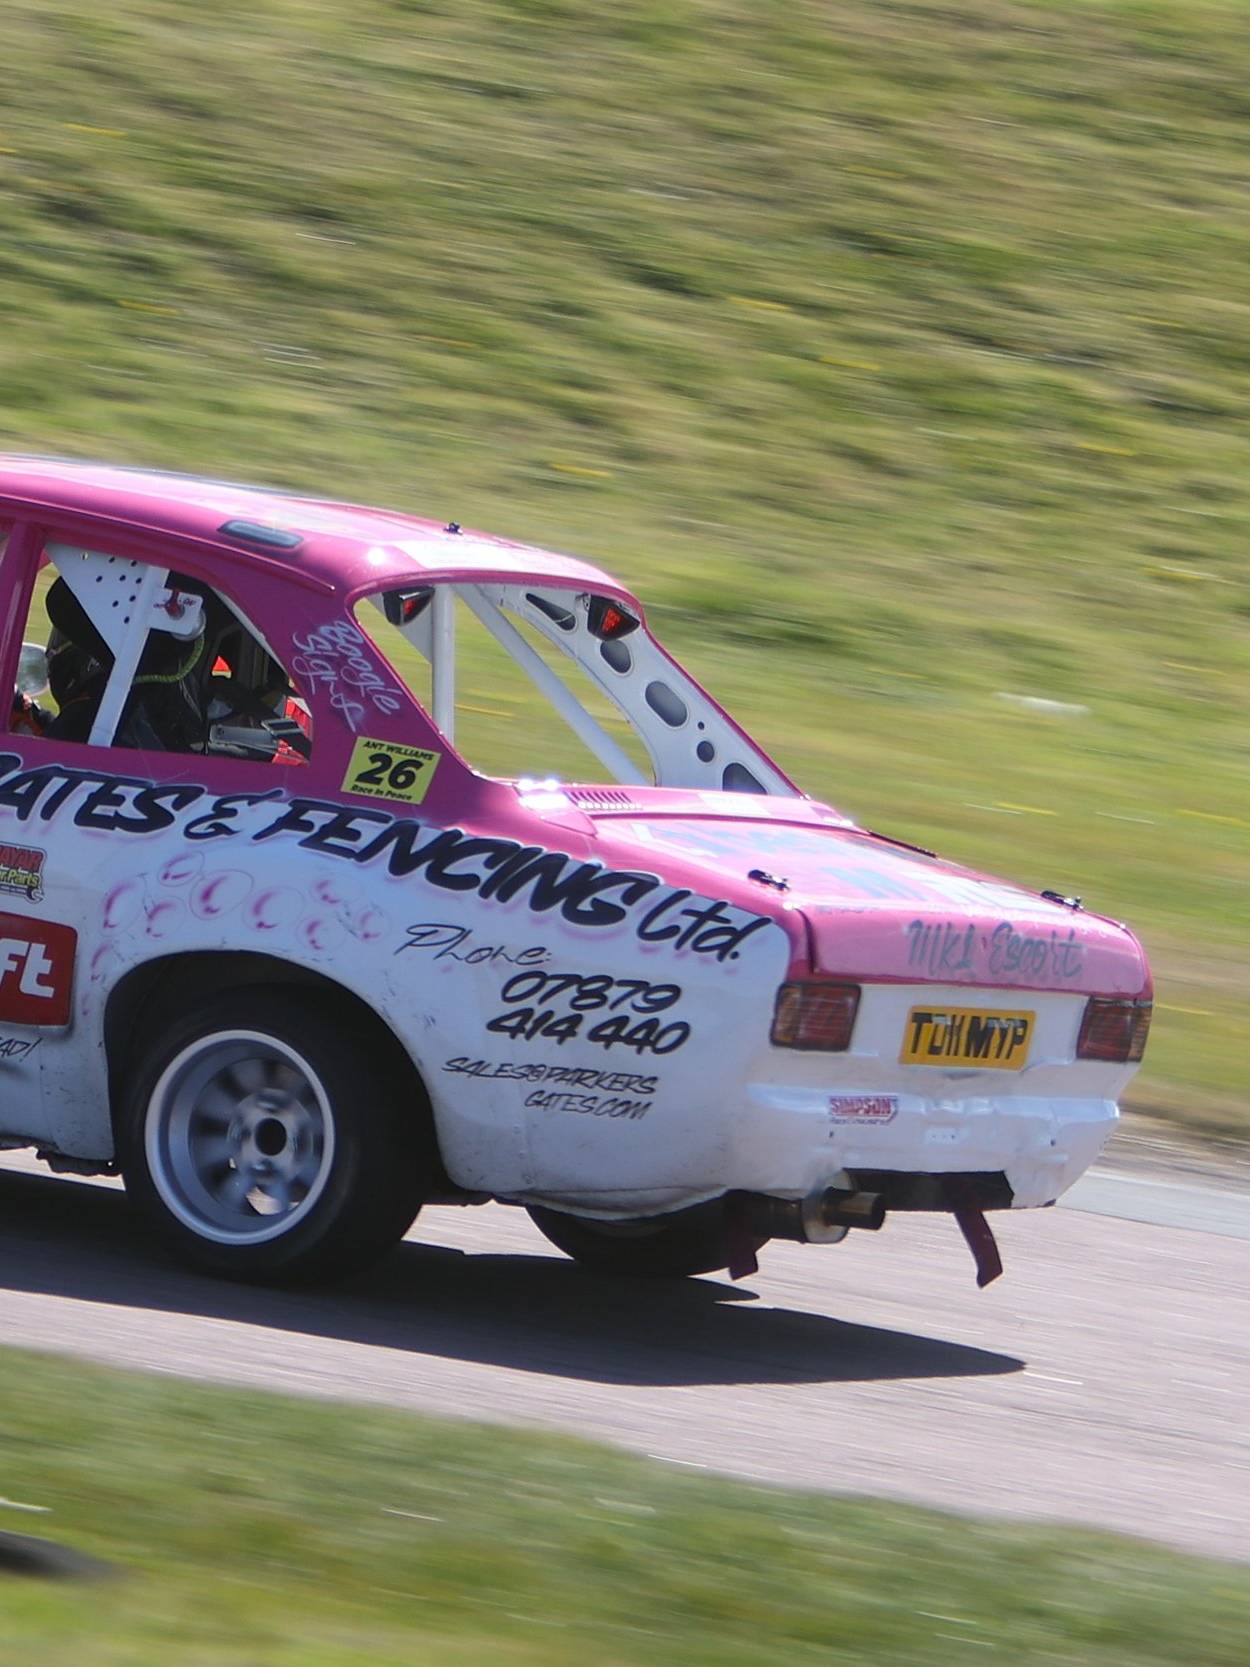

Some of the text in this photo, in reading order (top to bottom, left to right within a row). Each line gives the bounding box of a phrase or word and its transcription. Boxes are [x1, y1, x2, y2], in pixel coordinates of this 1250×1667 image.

[363, 740, 435, 761] ANT WILLIAMS
[354, 752, 424, 790] 26
[351, 784, 373, 794] Race
[385, 789, 413, 800] Peace
[7, 869, 40, 888] Parts
[183, 787, 286, 841] &
[252, 797, 662, 926] FENCING
[636, 887, 772, 963] Ltd.
[989, 921, 1083, 978] Escort
[500, 970, 682, 1014] 07879
[486, 1007, 691, 1055] 414 440
[442, 1056, 660, 1095] SALES@PARKERS
